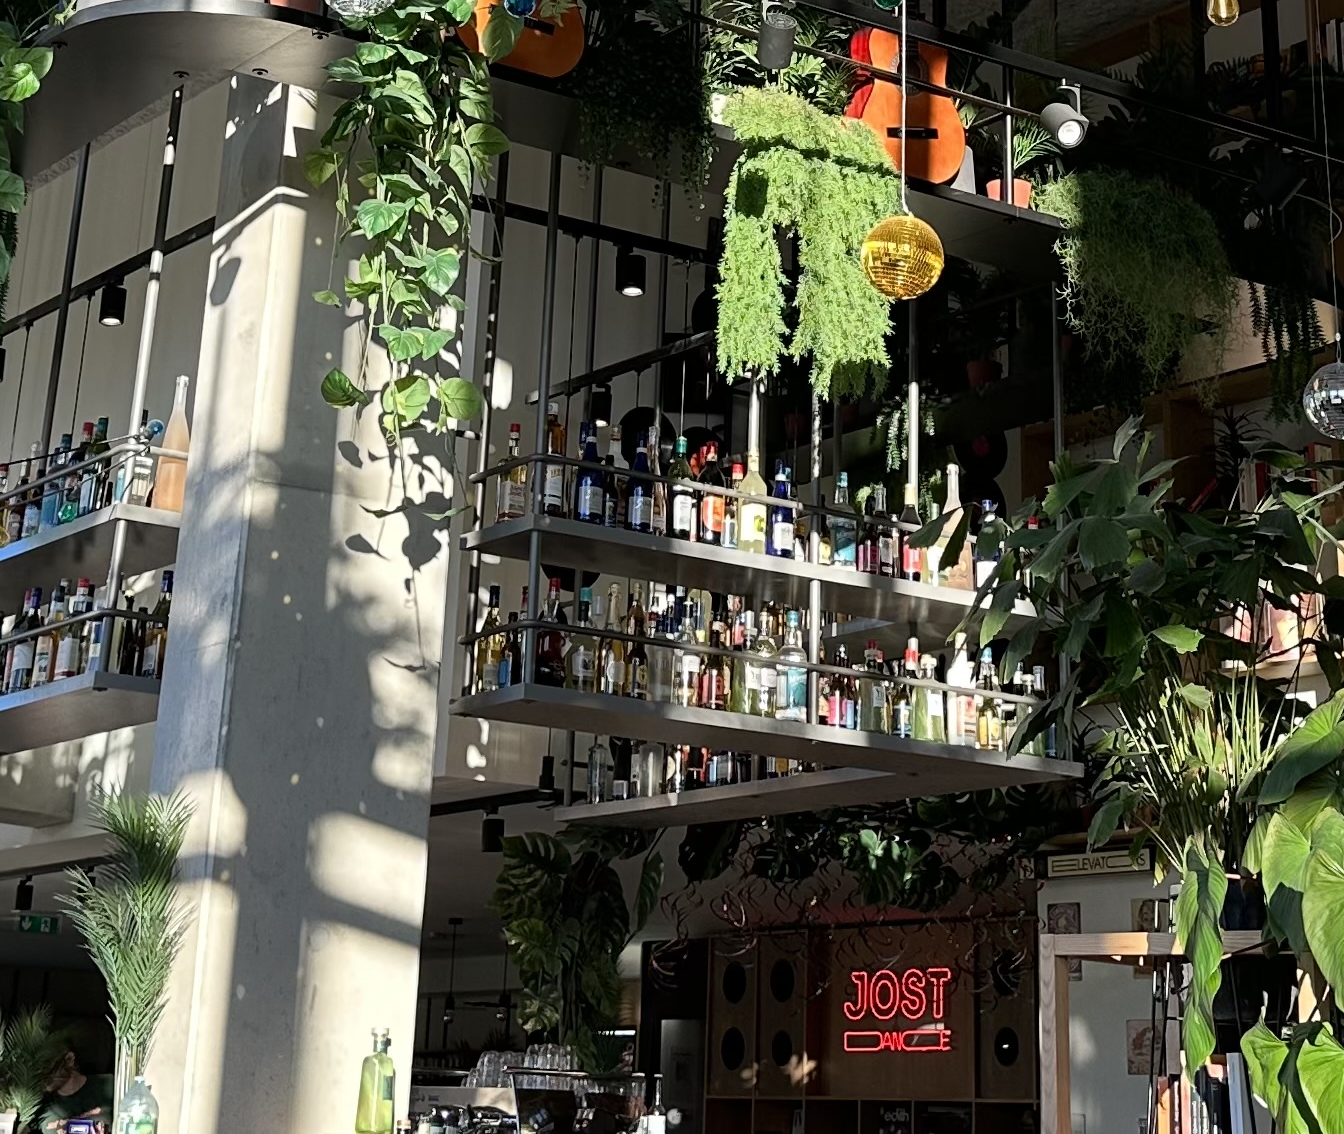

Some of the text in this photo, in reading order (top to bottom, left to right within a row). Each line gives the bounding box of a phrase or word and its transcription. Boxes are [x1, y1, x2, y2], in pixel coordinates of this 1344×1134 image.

[1051, 853, 1146, 873] ELEVATOS
[844, 967, 952, 1021] JOST
[844, 1029, 952, 1053] DANCE
